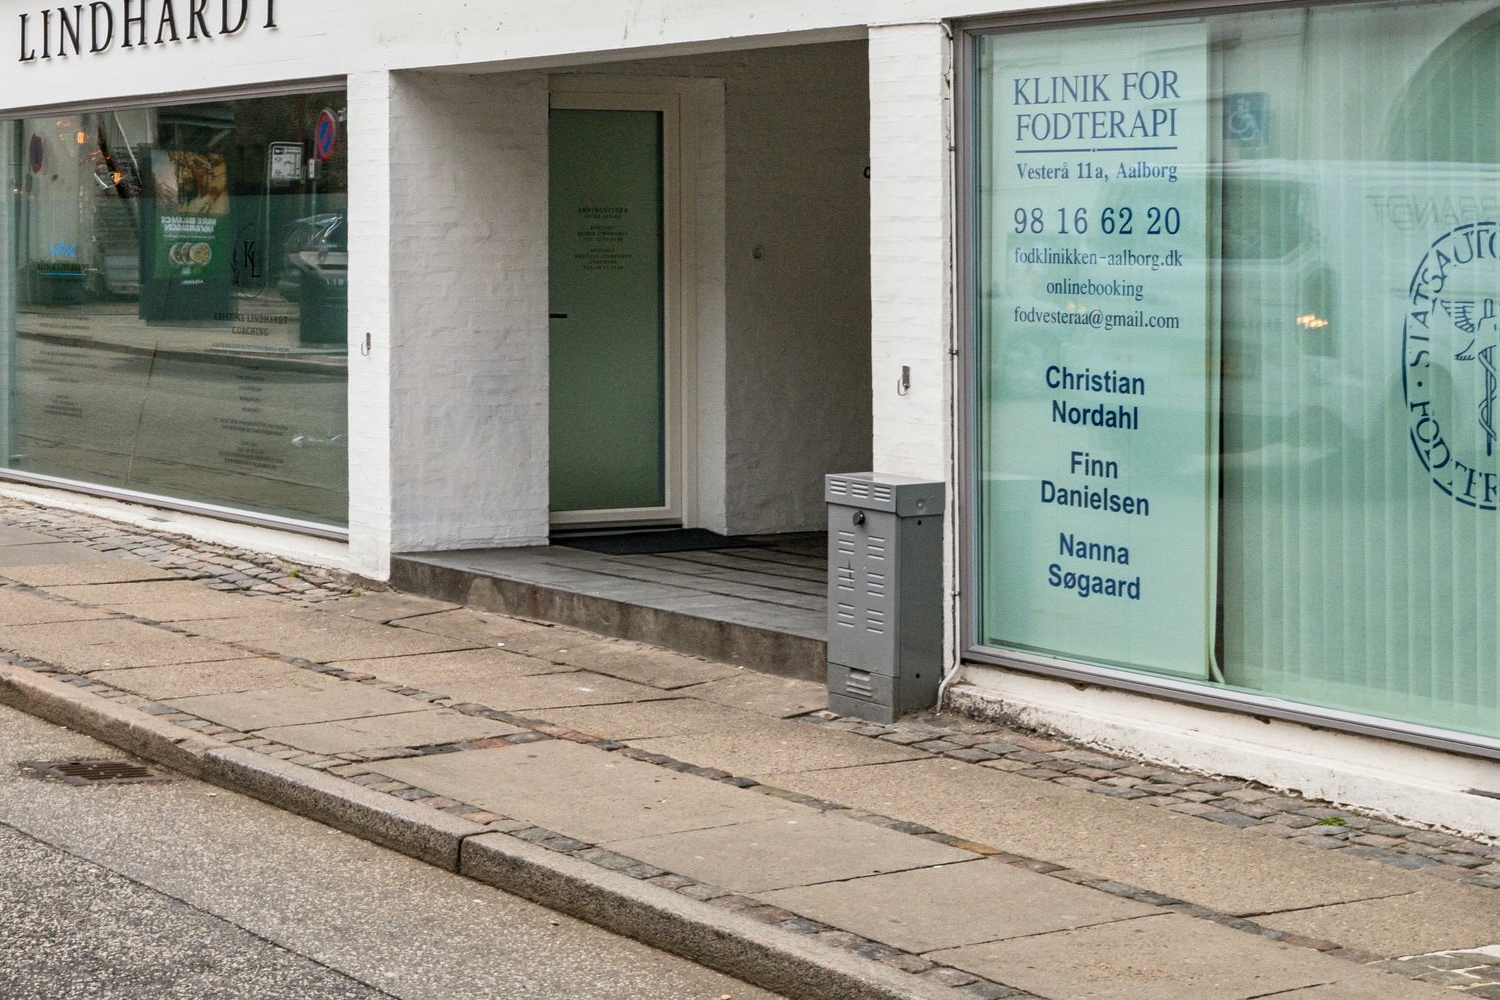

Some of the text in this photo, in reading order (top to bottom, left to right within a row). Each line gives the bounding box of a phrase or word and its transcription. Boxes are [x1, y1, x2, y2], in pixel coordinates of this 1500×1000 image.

[1013, 70, 1181, 105] KLINIK FOR
[1016, 108, 1178, 141] FODTERAPI
[1017, 162, 1178, 183] Vesterå 11a, Aalborg
[1014, 206, 1181, 235] 98 16 62 20
[1014, 248, 1183, 271] fodklinikken-aalborg.dk
[1046, 278, 1144, 301] onlinebooking
[231, 325, 269, 337] COACHING
[1014, 306, 1180, 331] fodvesteraa@gmail.com
[1045, 364, 1145, 396] Christian
[1052, 400, 1138, 430] Nordahl
[1070, 450, 1118, 479] Finn
[1040, 480, 1150, 516] Danielsen
[1059, 532, 1130, 565] Nanna
[1047, 563, 1141, 600] Søgaard
